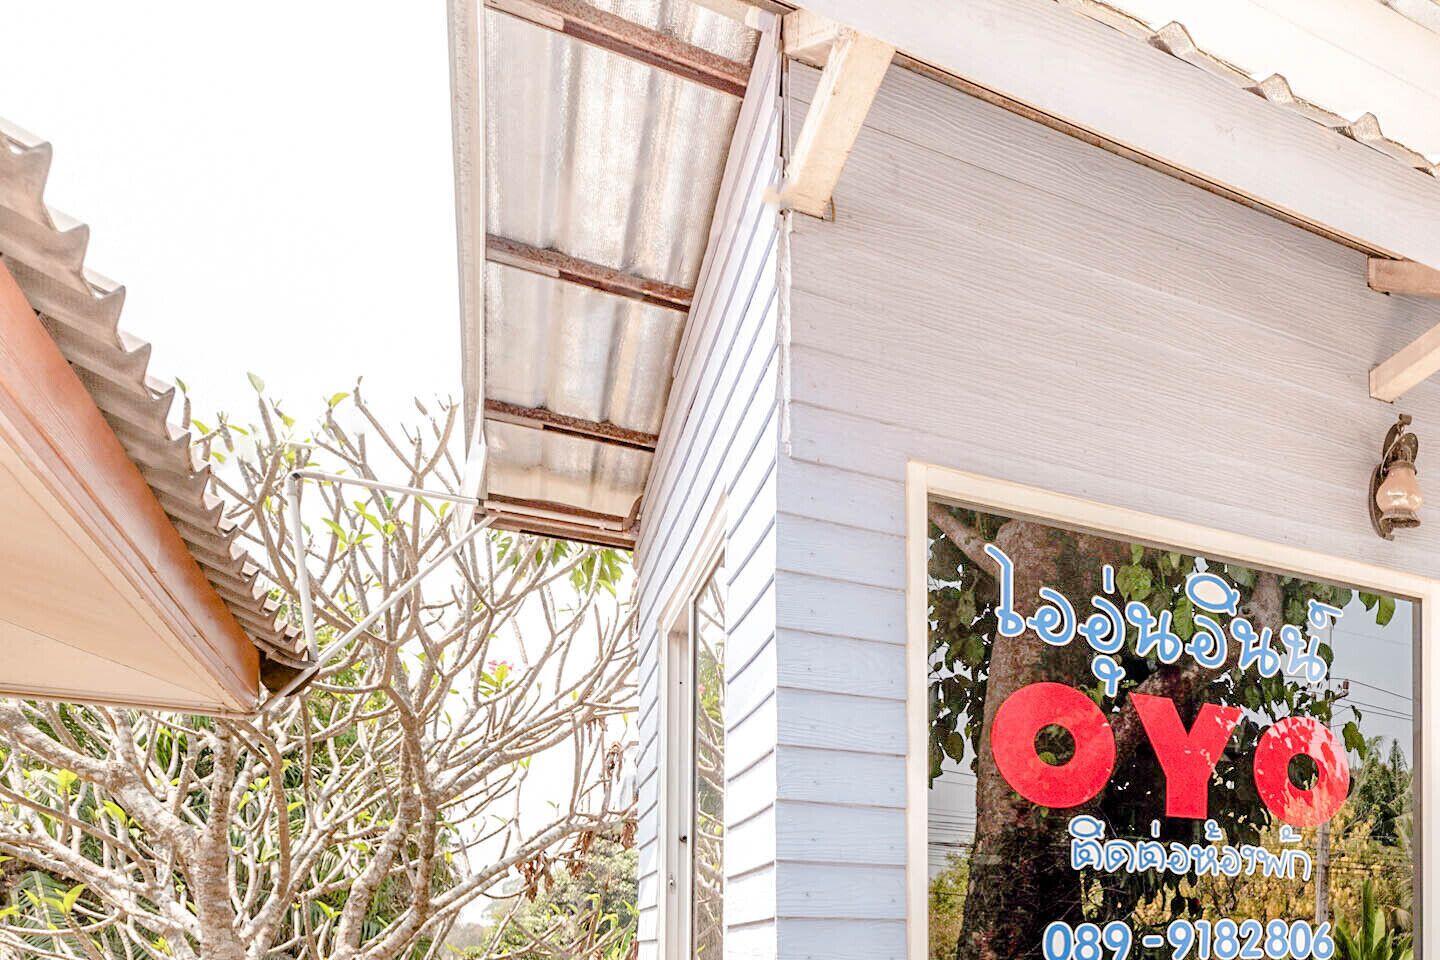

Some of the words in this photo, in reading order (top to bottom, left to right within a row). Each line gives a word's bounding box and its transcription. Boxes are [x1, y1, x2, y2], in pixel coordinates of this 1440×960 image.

[990, 682, 1350, 828] OYO
[1068, 814, 1312, 881] ติดต่อห้องพัก
